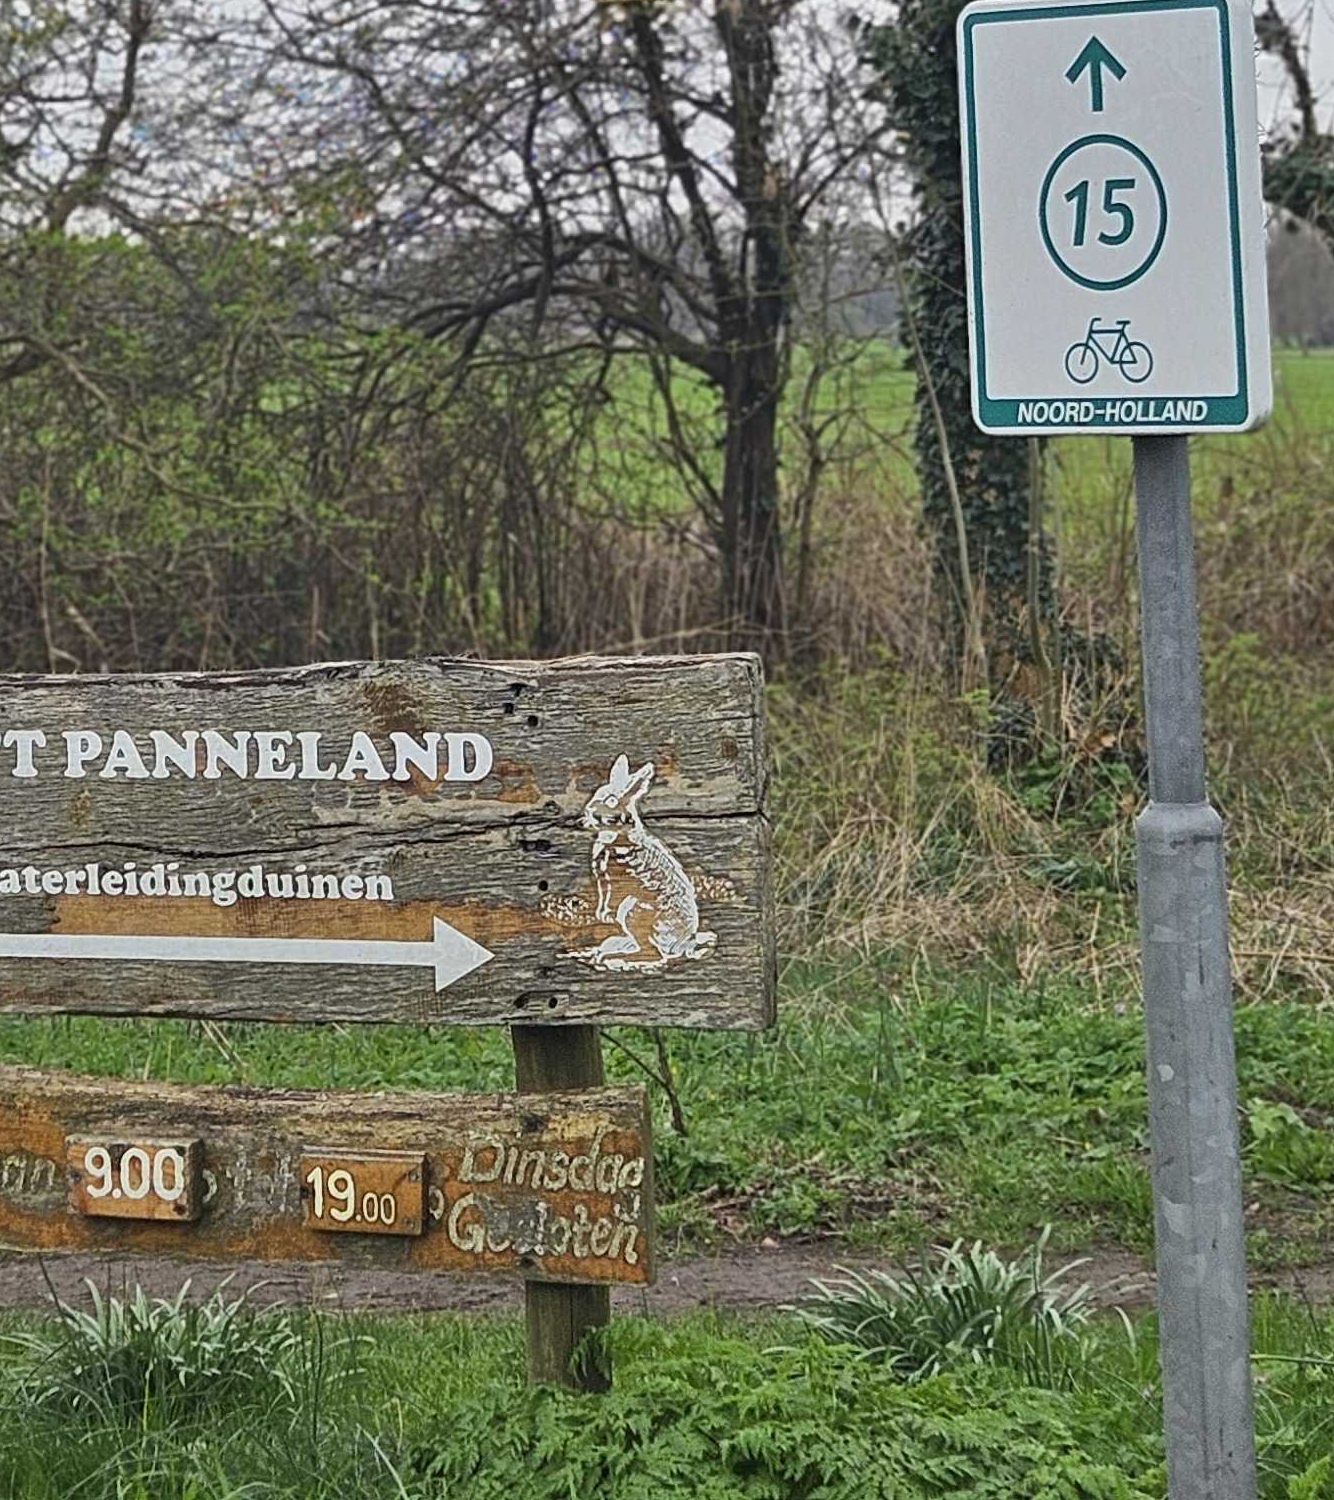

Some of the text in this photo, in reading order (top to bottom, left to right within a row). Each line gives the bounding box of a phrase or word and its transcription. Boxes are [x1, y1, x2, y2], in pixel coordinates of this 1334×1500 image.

[1064, 178, 1136, 246] 15
[1017, 400, 1208, 425] NOORD-HOLLAND
[62, 729, 494, 782] PANNELAND
[83, 1146, 185, 1201] 9.00
[306, 1164, 397, 1226] 19.00
